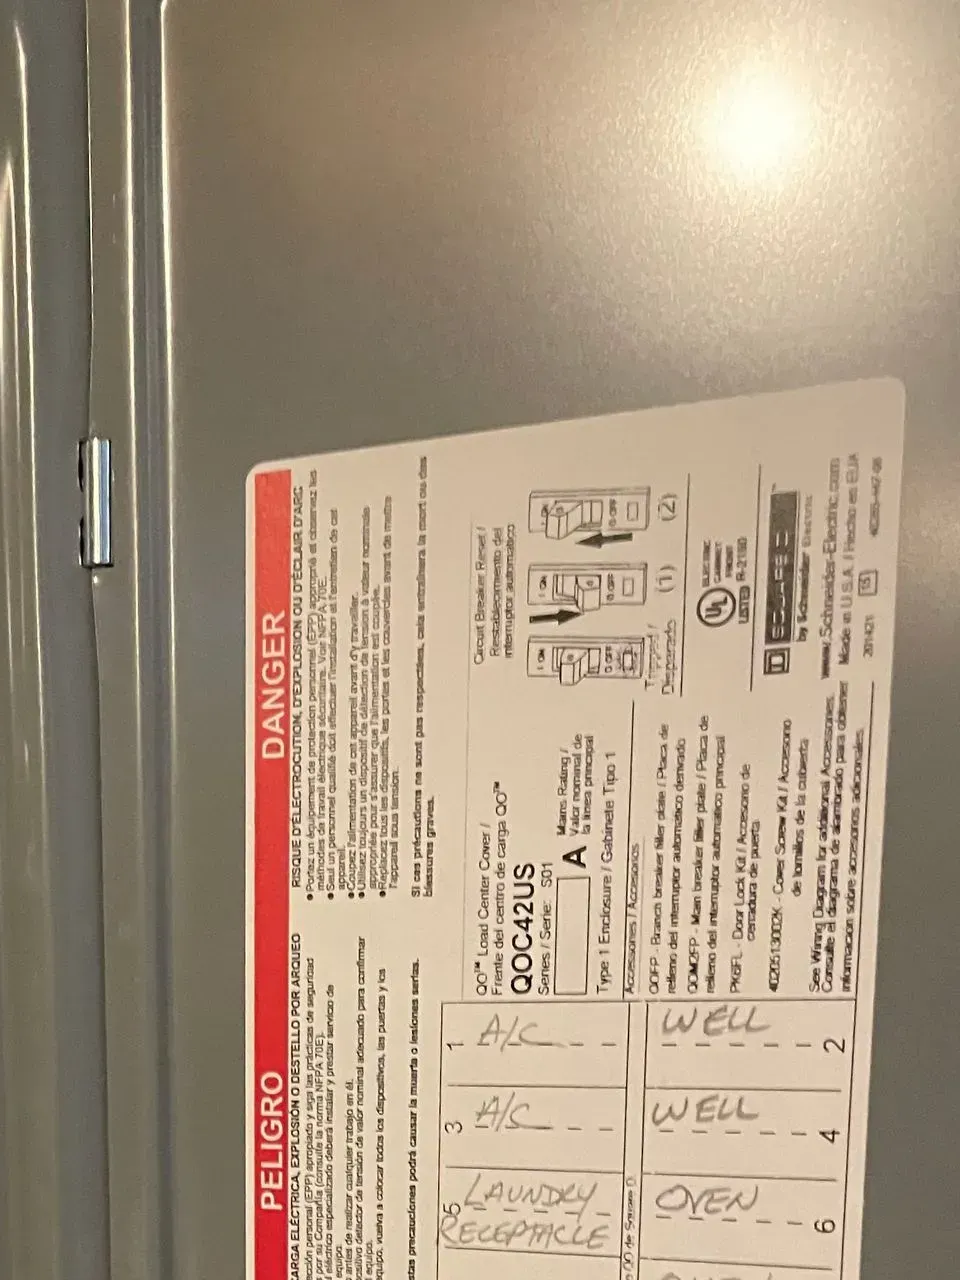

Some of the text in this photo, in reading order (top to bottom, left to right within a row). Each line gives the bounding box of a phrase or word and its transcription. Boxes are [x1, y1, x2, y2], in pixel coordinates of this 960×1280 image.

[657, 492, 678, 522] (2)
[656, 564, 677, 594] (1)
[262, 611, 286, 759] DANGER
[556, 756, 574, 837] Mains Rating
[292, 839, 302, 888] RISQUE
[561, 846, 587, 869] A
[477, 832, 492, 957] Load Center Cover
[596, 762, 619, 995] Type Enclosure Gabinete Tipo
[491, 820, 510, 996] Frente del centro de carga
[510, 862, 536, 996] QOC42US
[538, 862, 553, 996] Series Serie: S01
[291, 933, 301, 988] ARQUEO
[291, 991, 301, 1017] POR
[661, 1005, 772, 1037] WELL
[291, 1020, 301, 1083] DESTELLO
[446, 1042, 464, 1050] 1
[479, 1014, 553, 1053] A/C
[822, 1038, 846, 1053] 2
[444, 1121, 463, 1133] 3
[475, 1092, 553, 1132] A/C
[652, 1095, 760, 1126] WELL
[260, 1071, 284, 1210] PELIGRO
[819, 1130, 840, 1143] 4
[443, 1202, 462, 1216] 5
[464, 1173, 598, 1221] LAUNDRY
[655, 1184, 760, 1215] OVEN
[814, 1219, 836, 1233] 6
